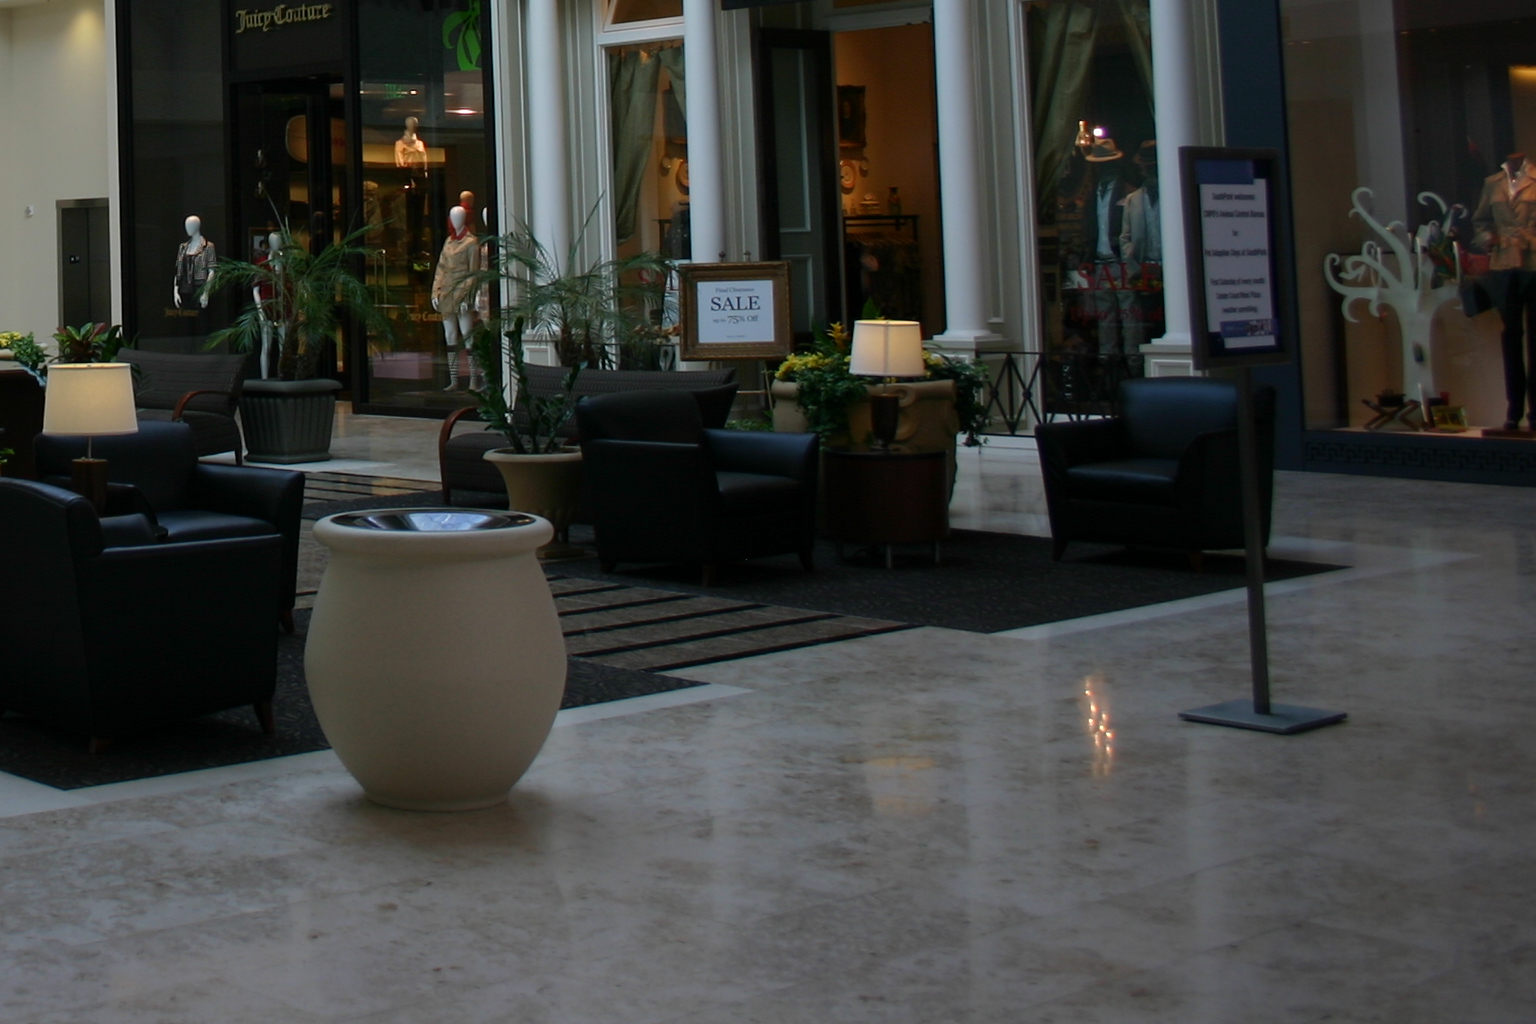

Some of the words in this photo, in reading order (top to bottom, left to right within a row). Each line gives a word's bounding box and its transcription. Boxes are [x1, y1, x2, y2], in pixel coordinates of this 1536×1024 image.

[235, 8, 272, 34] Juicy
[274, 3, 334, 25] Couture
[1077, 262, 1162, 292] SALE
[710, 296, 761, 312] SALE
